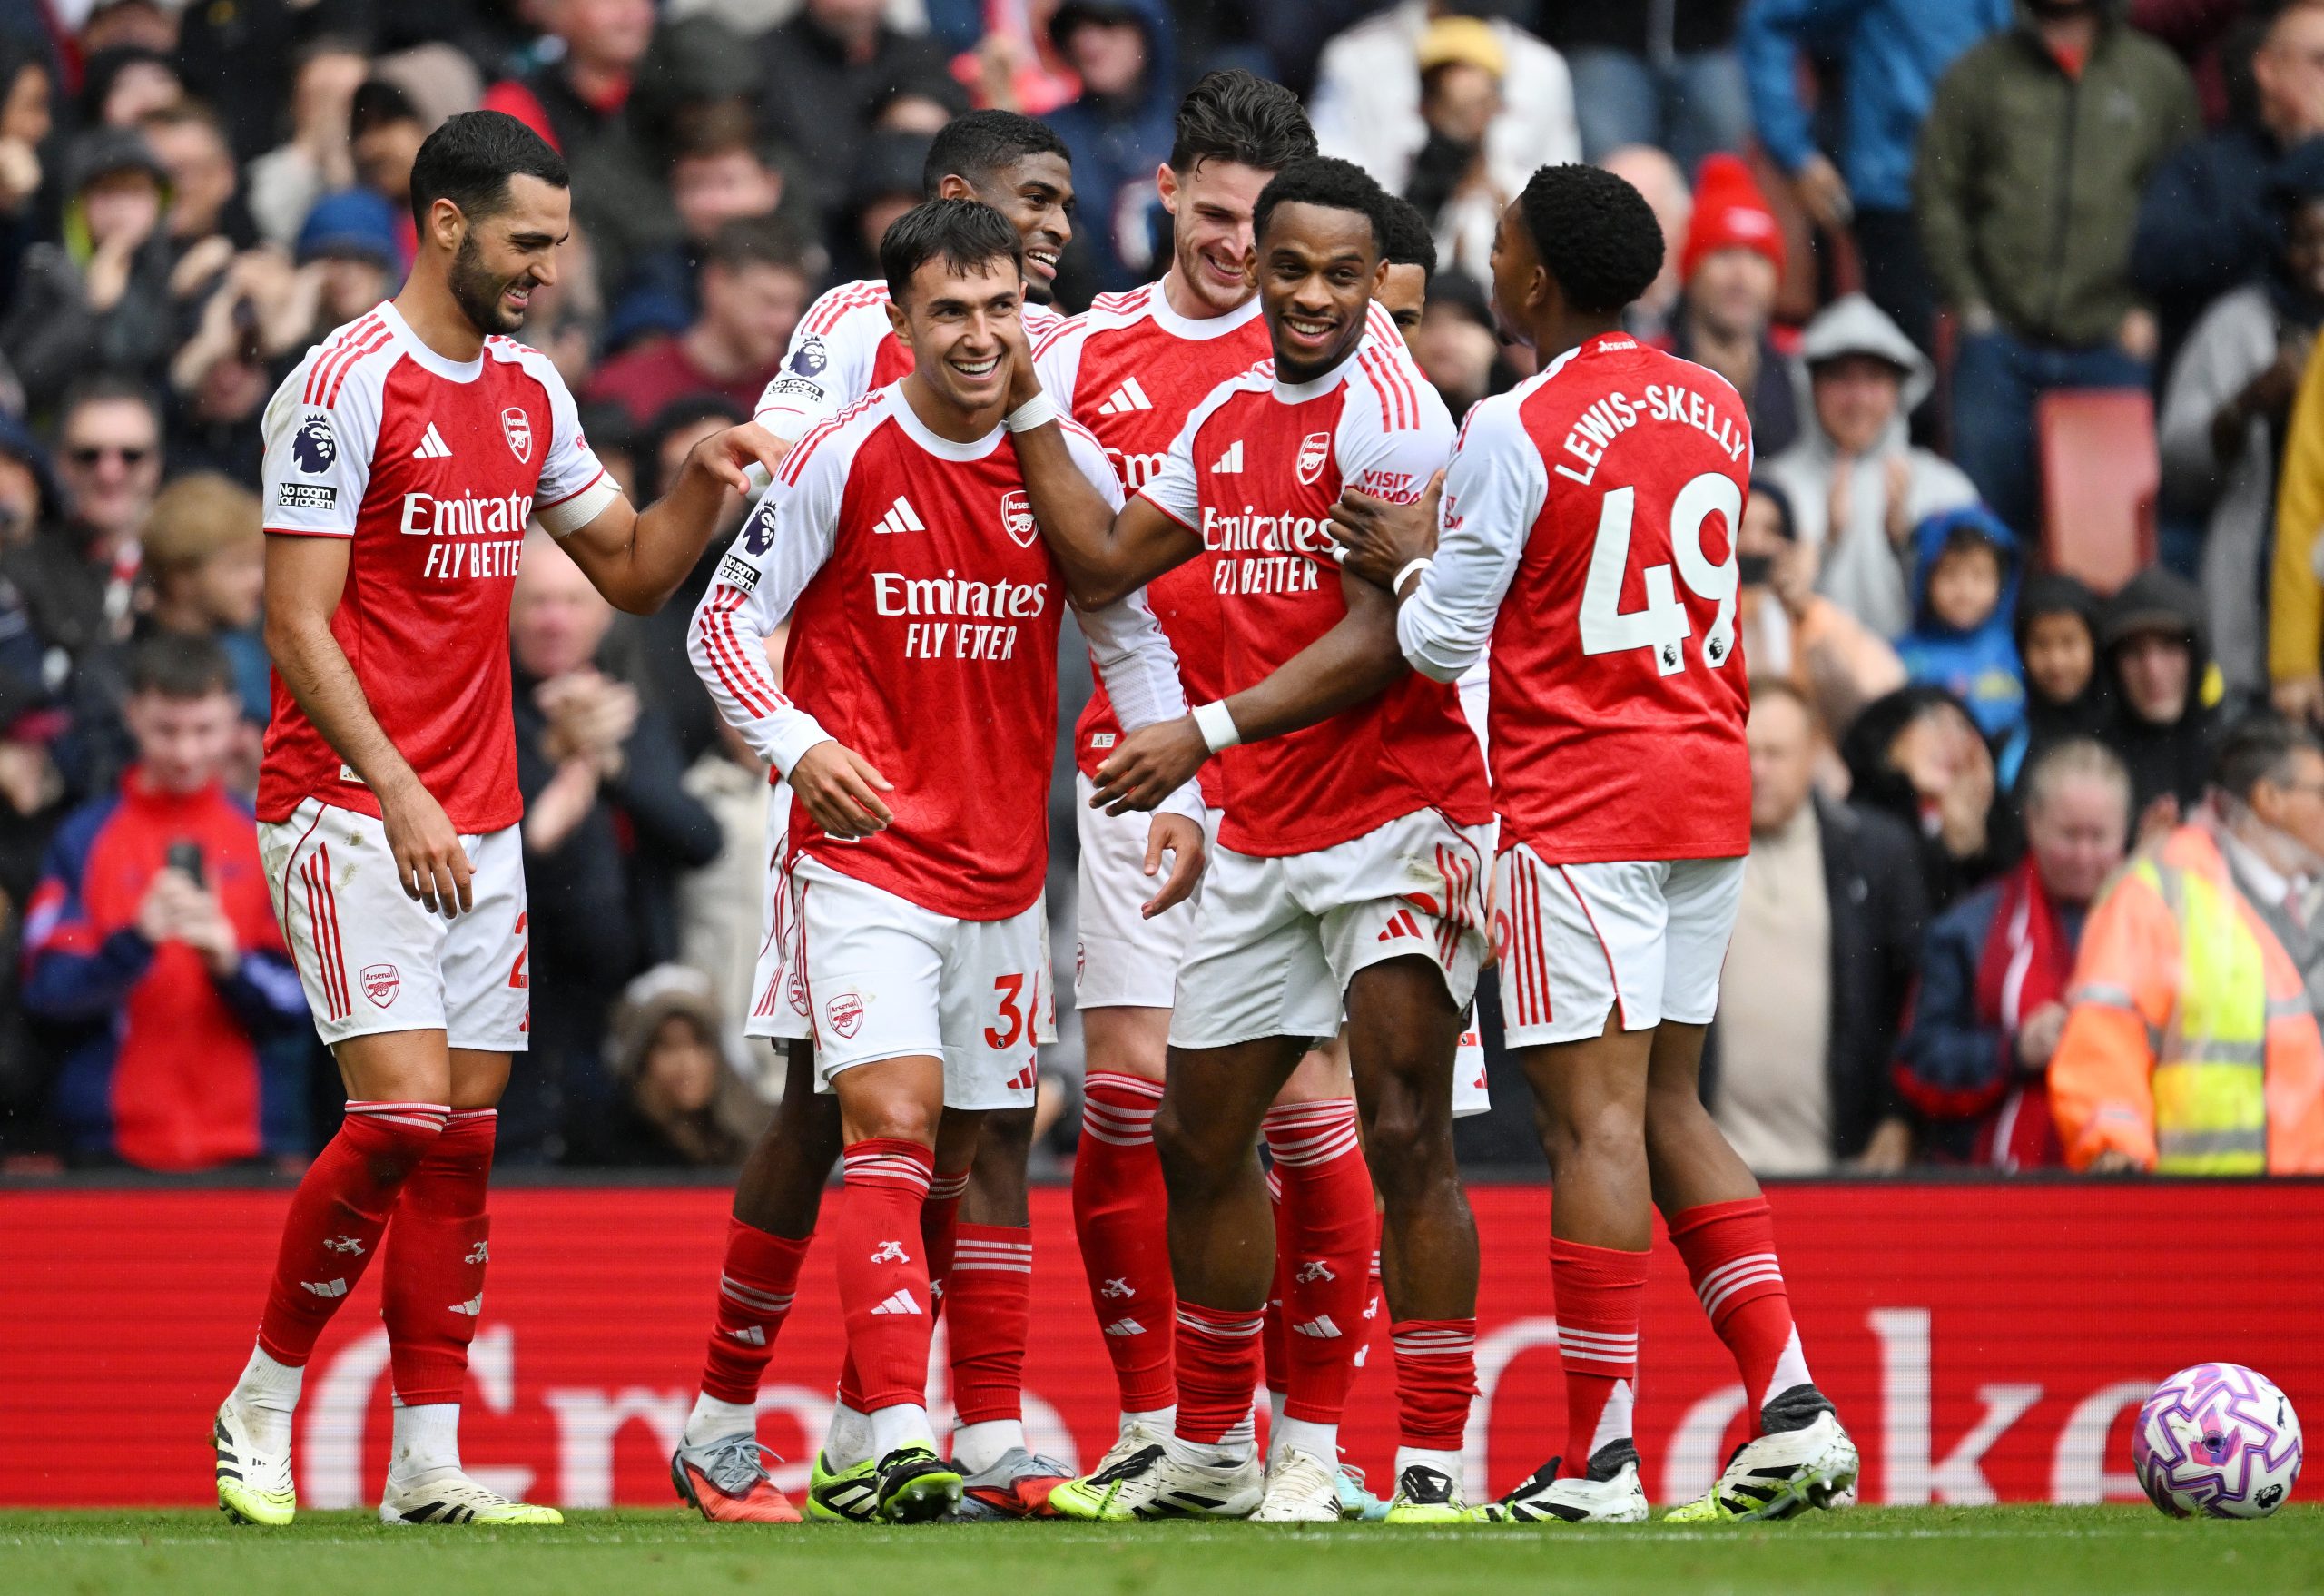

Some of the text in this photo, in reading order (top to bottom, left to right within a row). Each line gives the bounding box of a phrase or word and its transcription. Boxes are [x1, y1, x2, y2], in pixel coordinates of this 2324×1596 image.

[1554, 384, 1747, 486] LEWIS-SKELLY
[279, 483, 330, 499] No room
[1363, 469, 1413, 488] VISIT
[295, 497, 335, 509] racism
[1203, 505, 1341, 554] Emirates
[423, 540, 524, 579] FLY BETTE
[1241, 557, 1319, 595] BETTER
[1579, 472, 1742, 677] 49
[872, 569, 1048, 618] Emirates
[905, 623, 949, 659] FLY
[365, 970, 393, 980] Arsenal
[831, 1000, 857, 1014] Arsenal
